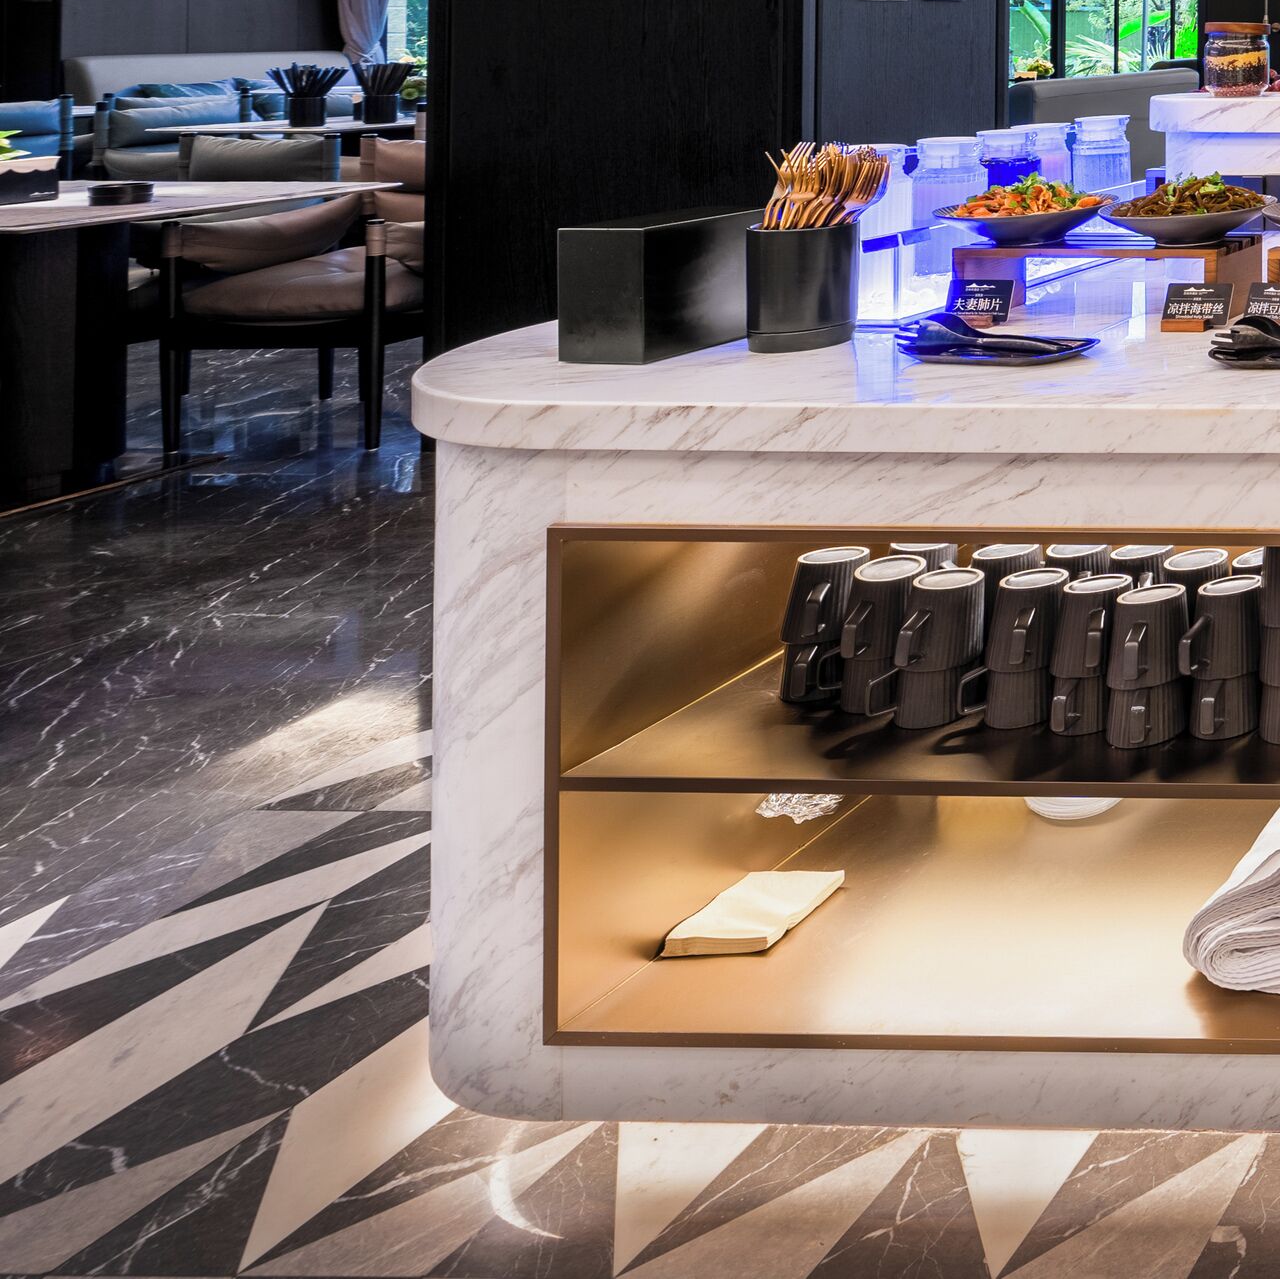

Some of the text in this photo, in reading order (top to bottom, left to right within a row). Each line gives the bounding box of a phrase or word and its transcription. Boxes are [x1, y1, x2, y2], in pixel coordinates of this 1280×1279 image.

[952, 297, 1003, 311] 夫妻肺片
[1167, 302, 1224, 315] 凉拌海带丝
